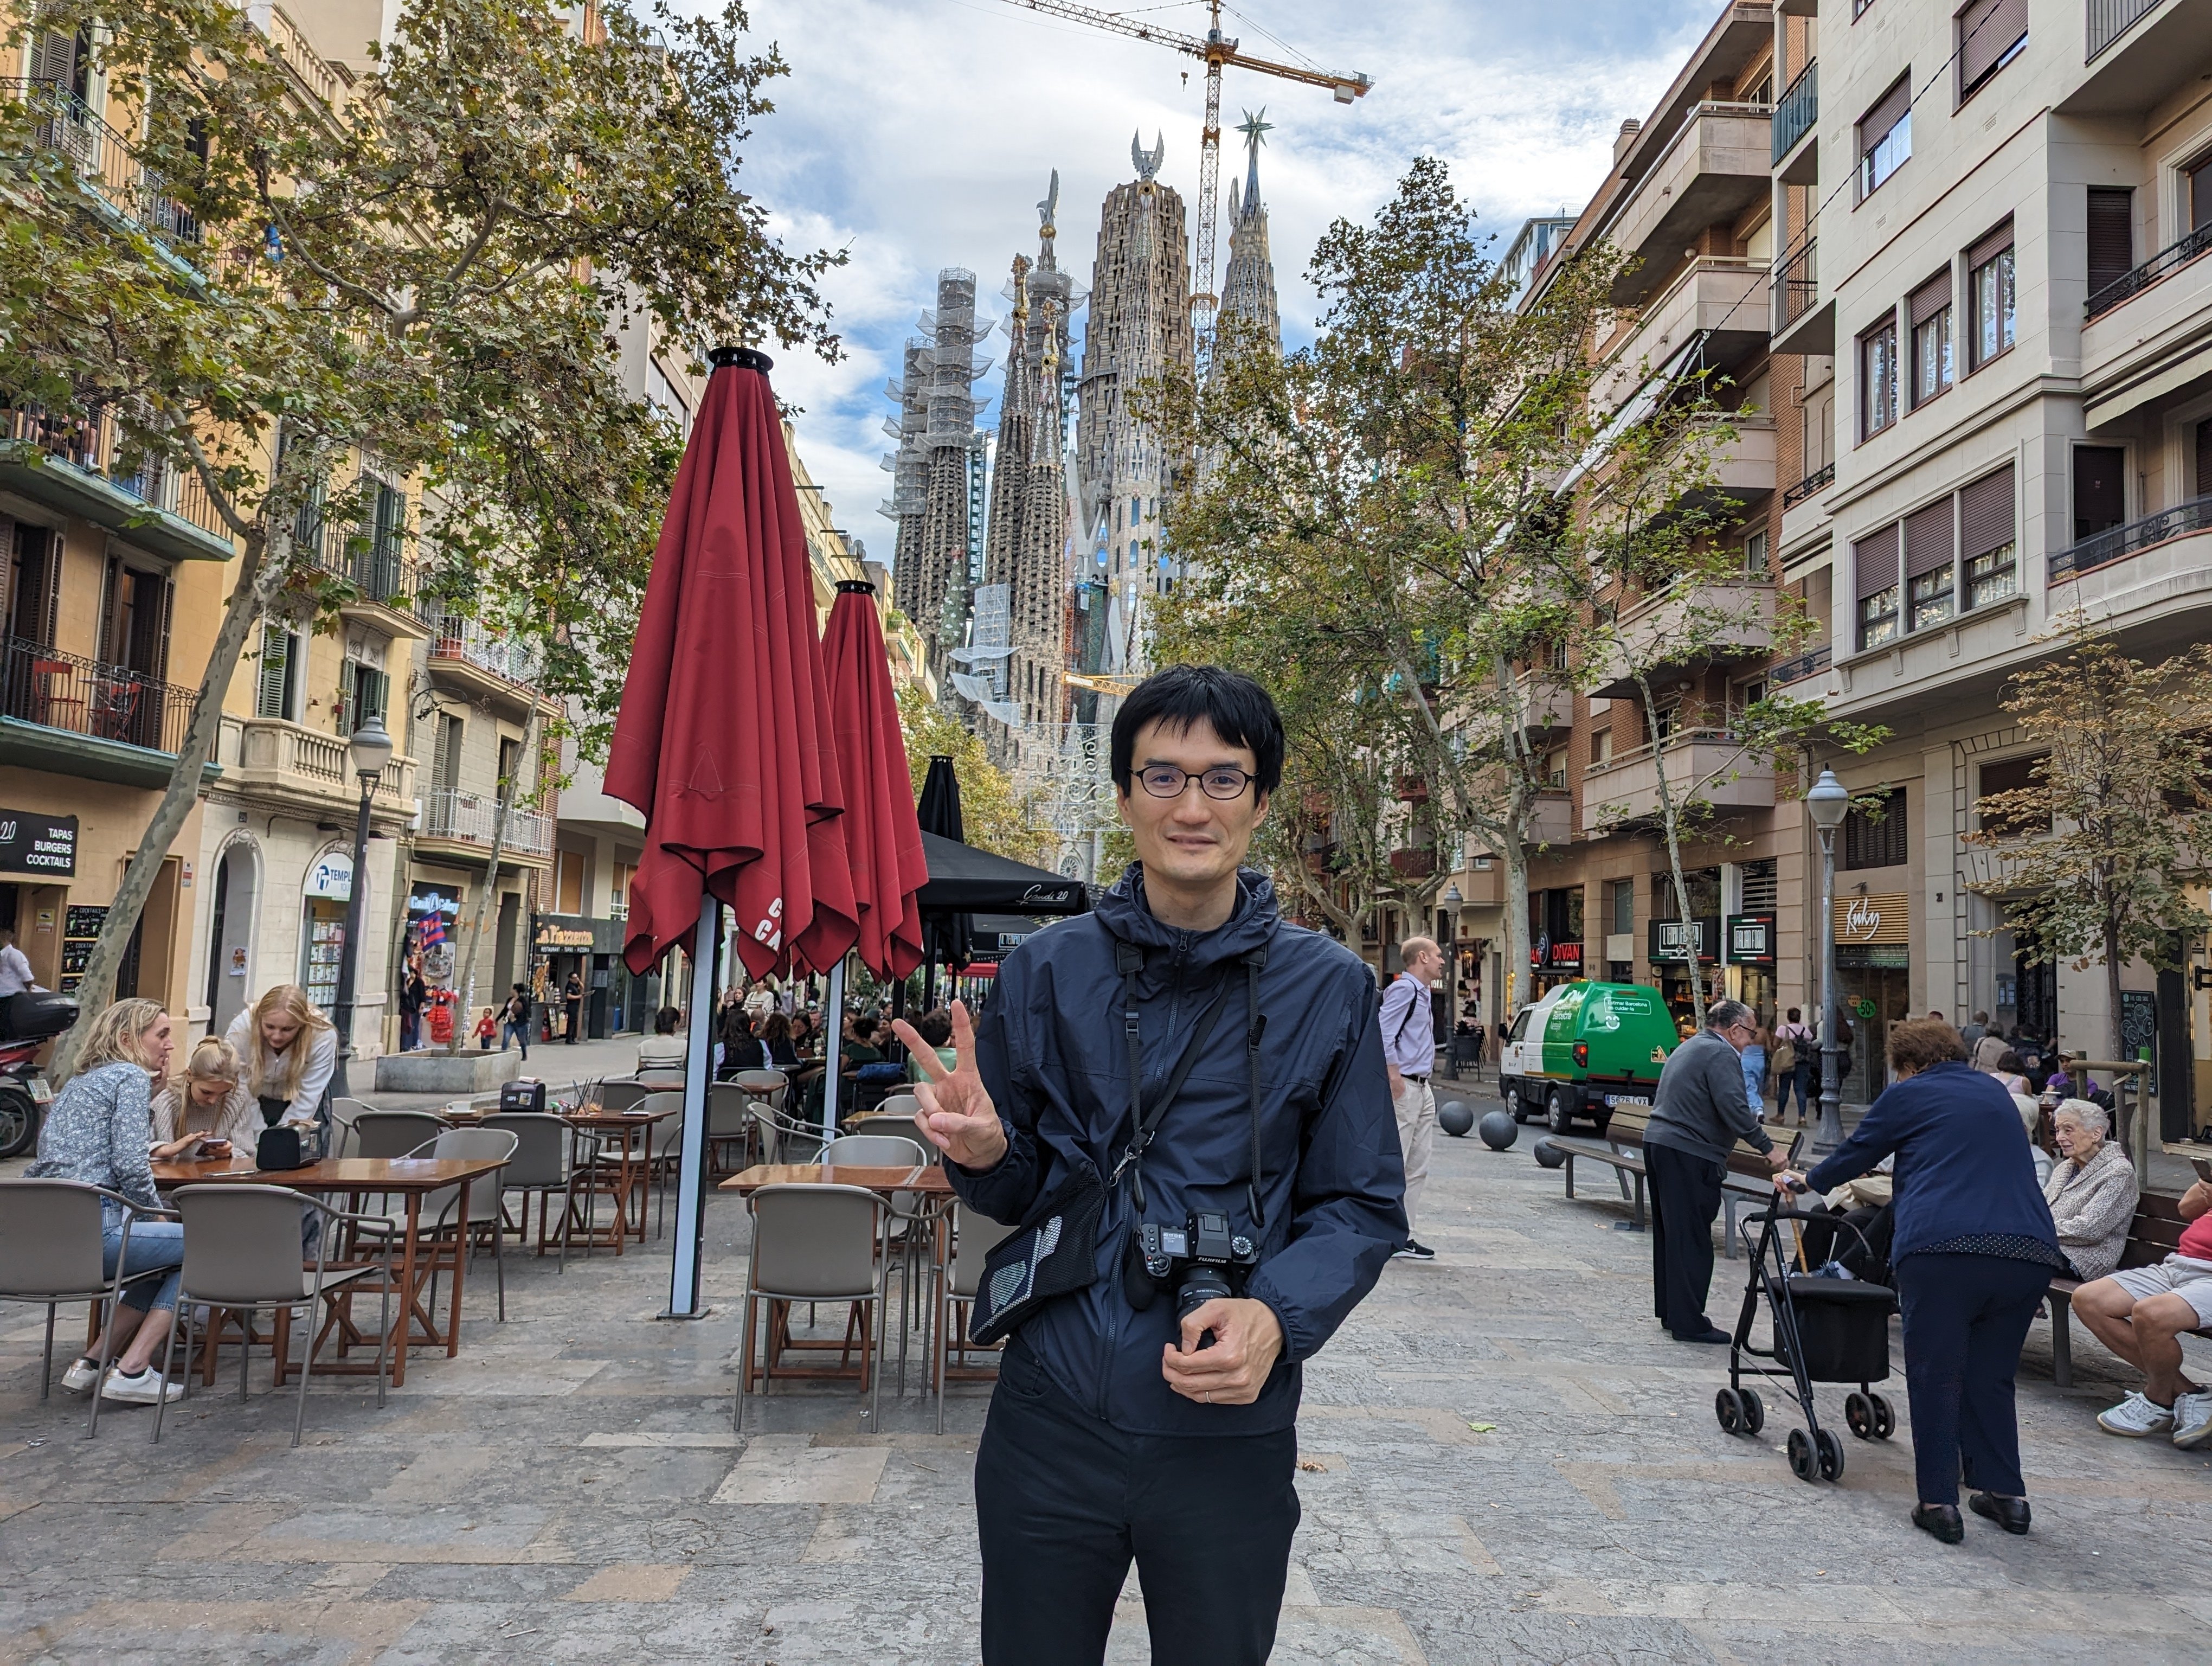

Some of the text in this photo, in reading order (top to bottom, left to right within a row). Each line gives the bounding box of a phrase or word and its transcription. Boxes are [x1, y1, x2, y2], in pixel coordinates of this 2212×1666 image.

[48, 828, 73, 841] TAPAS
[34, 840, 72, 854] BURGERS
[26, 854, 71, 868] COCKTAILS
[330, 869, 351, 882] TEMPL
[1056, 891, 1069, 900] 20
